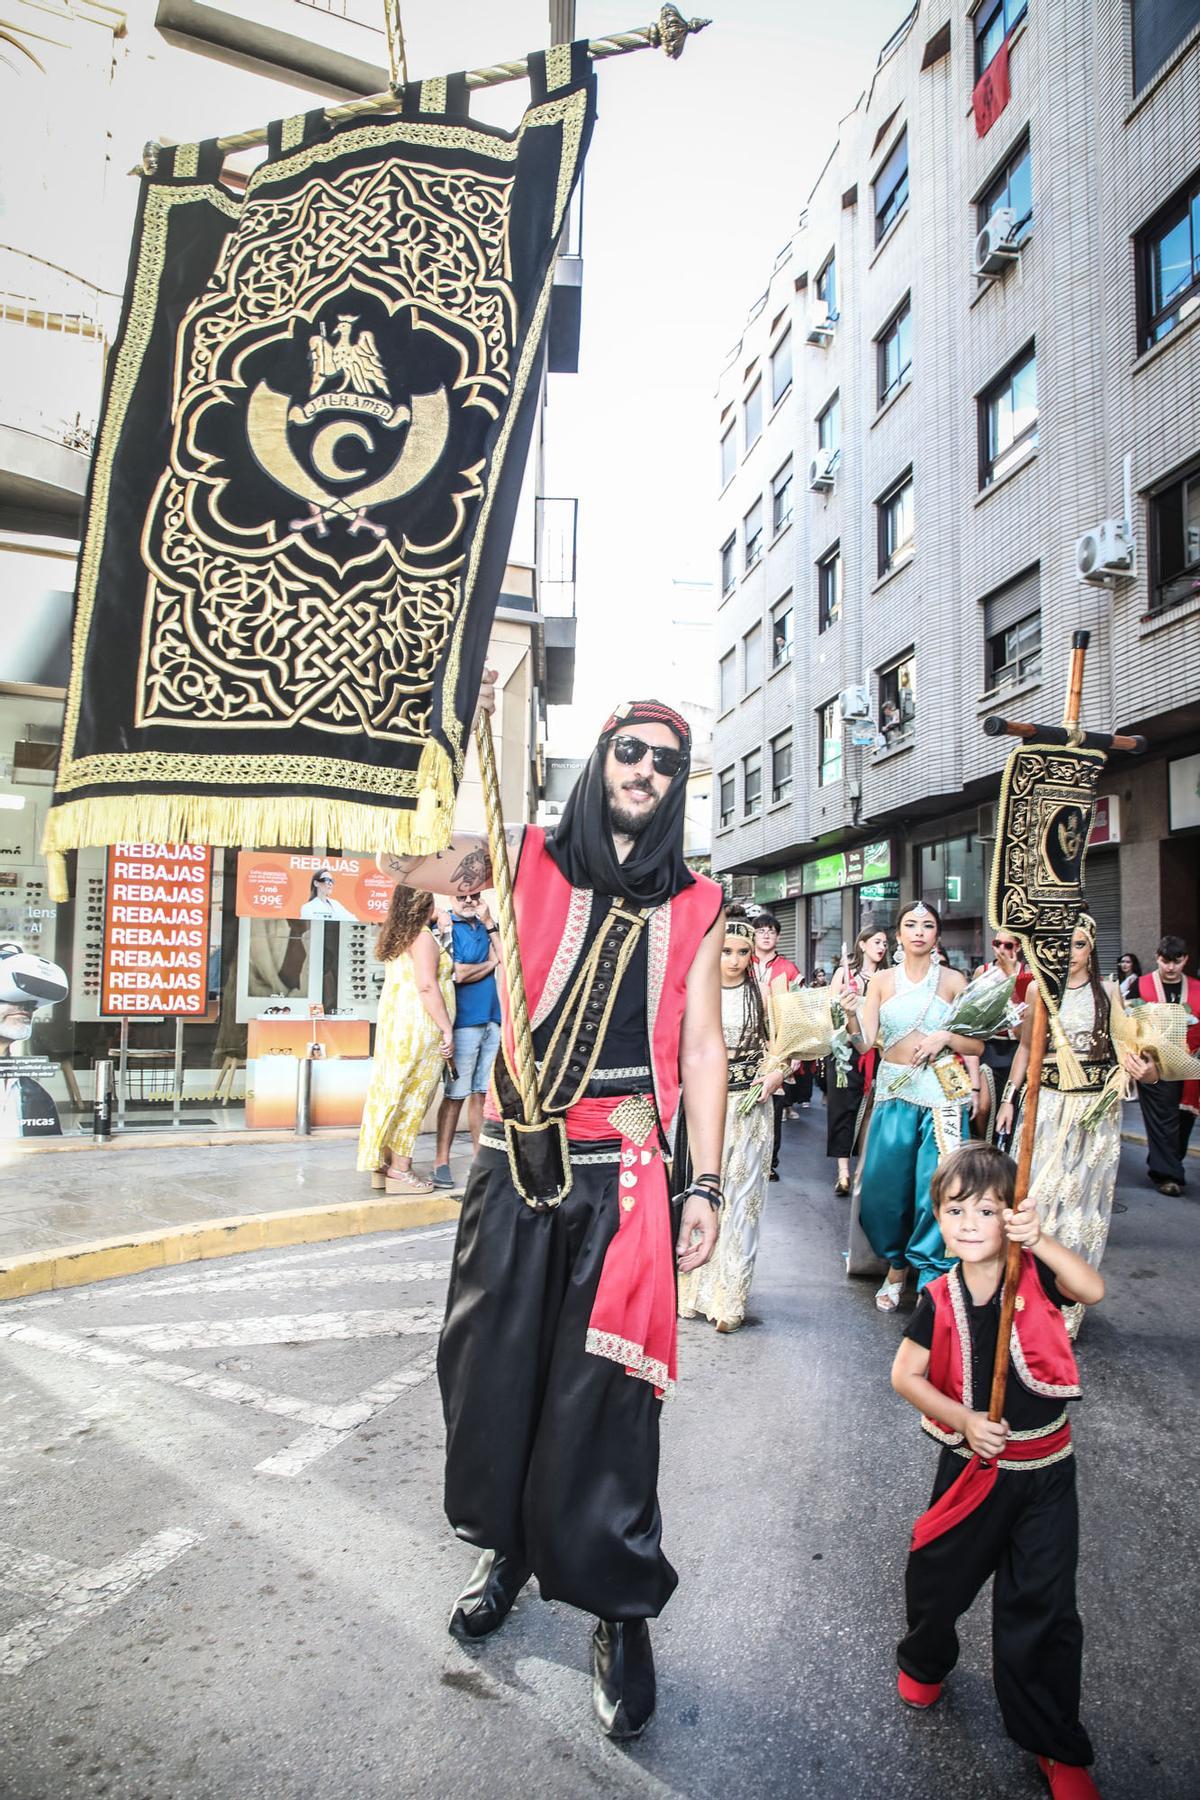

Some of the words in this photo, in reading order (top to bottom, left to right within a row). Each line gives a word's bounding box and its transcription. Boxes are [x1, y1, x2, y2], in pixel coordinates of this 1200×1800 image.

[115, 842, 206, 861] REBAJAS
[114, 862, 205, 883] REBAJAS
[290, 856, 360, 873] REBAJAS
[113, 884, 204, 904] REBAJAS
[253, 895, 283, 905] 199€
[28, 906, 57, 919] lens
[367, 899, 389, 911] 99€
[112, 906, 203, 925] REBAJAS
[111, 928, 202, 946] REBAJAS
[110, 950, 202, 968] REBAJAS
[109, 972, 201, 989] REBAJAS
[108, 994, 200, 1011] REBAJAS
